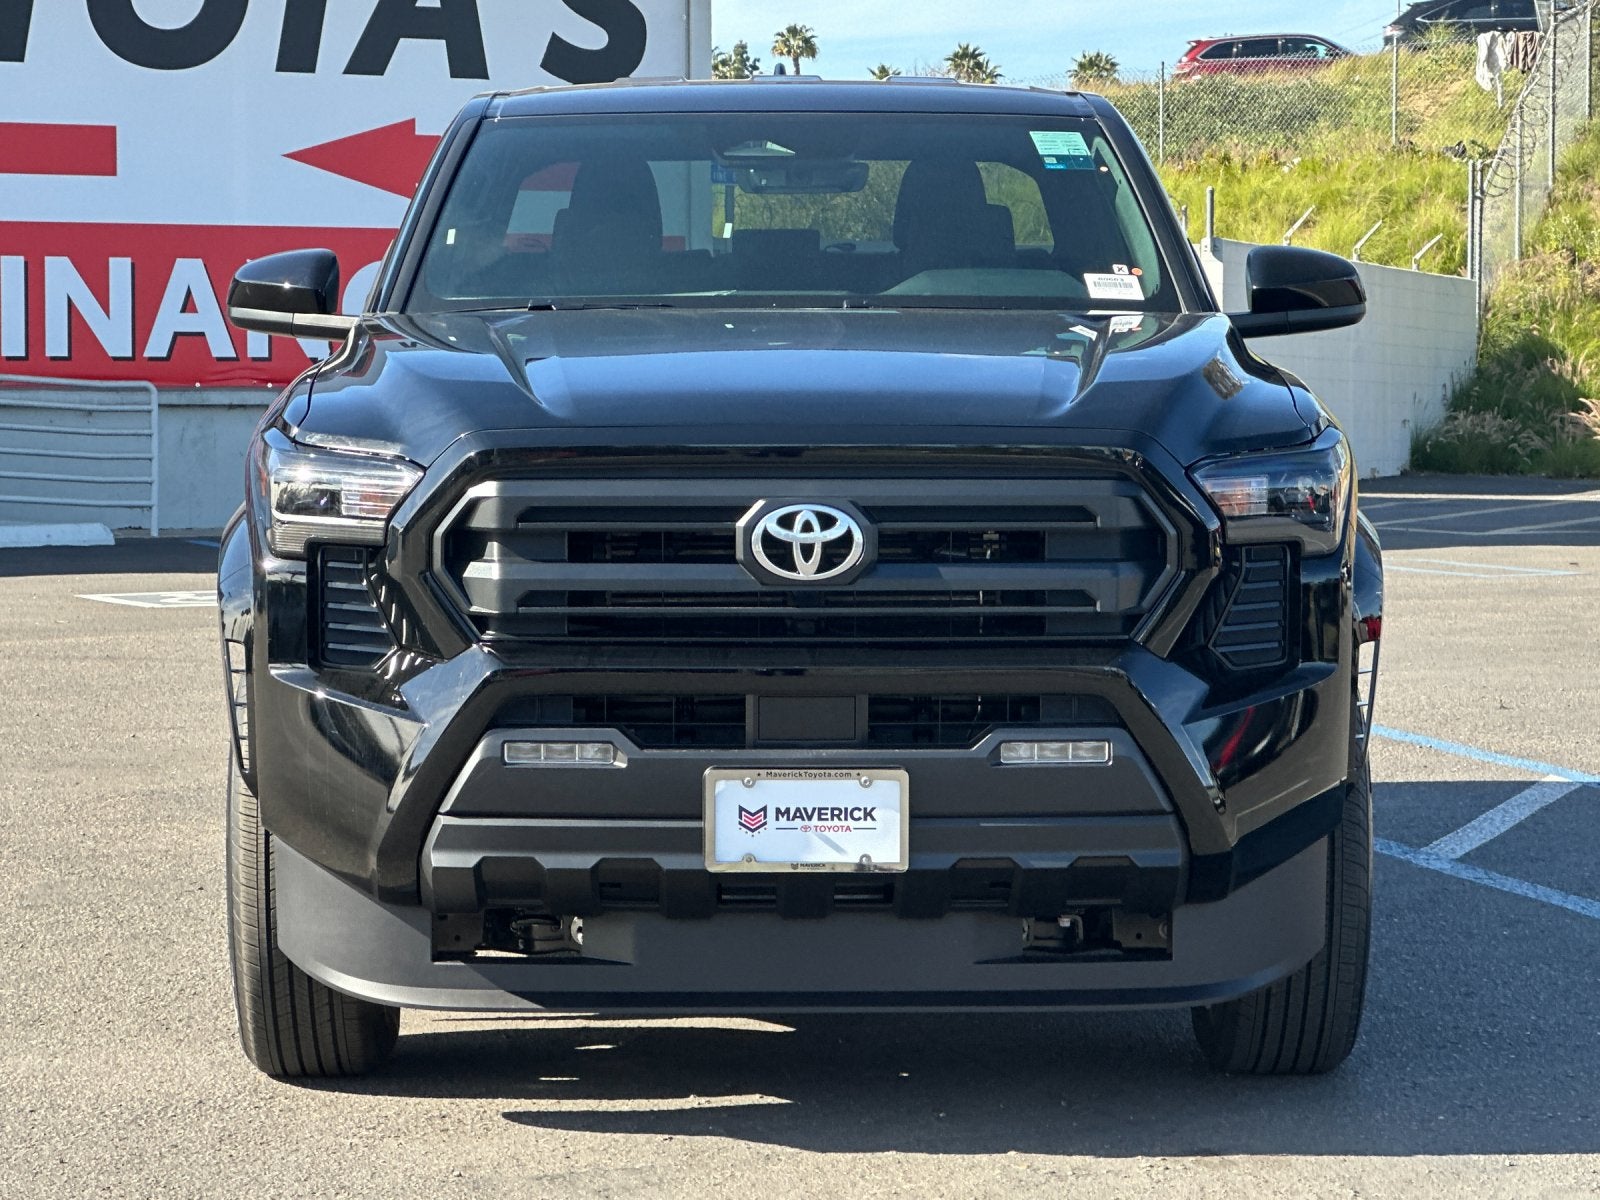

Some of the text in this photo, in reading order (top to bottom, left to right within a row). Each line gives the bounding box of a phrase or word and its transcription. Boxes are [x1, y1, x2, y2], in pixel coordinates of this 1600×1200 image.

[765, 771, 852, 779] MaverickToyota.com
[775, 806, 877, 822] MAVERICK
[813, 825, 852, 833] TOYOTA
